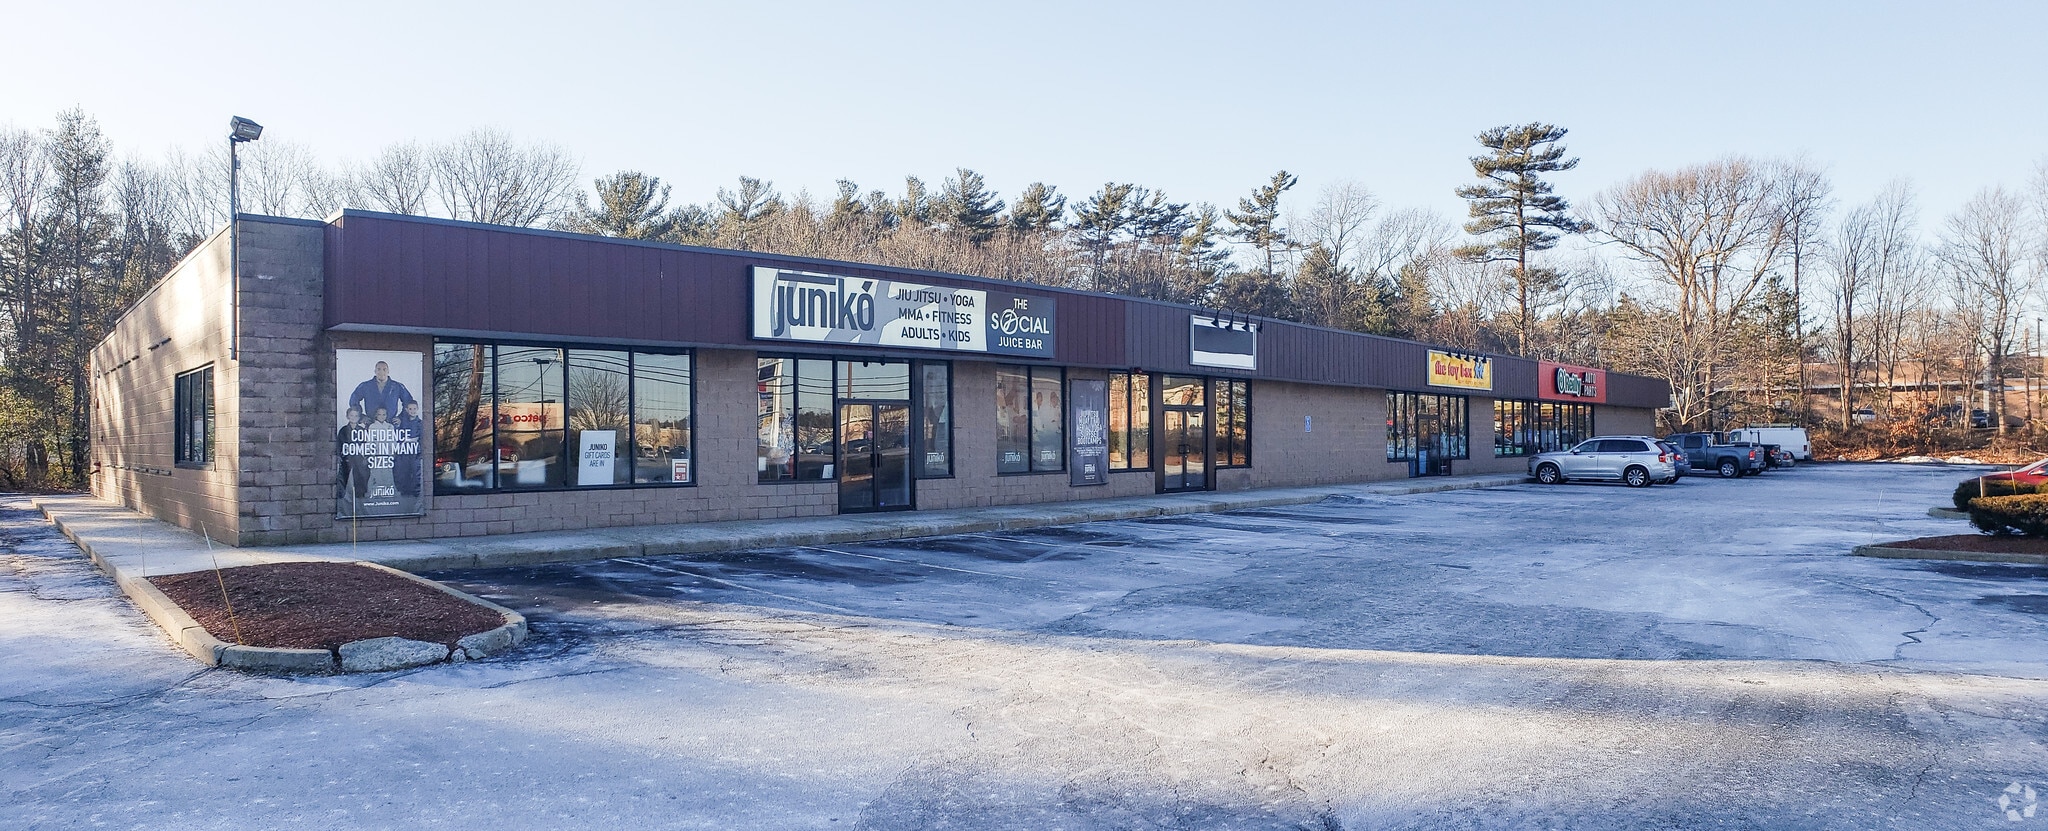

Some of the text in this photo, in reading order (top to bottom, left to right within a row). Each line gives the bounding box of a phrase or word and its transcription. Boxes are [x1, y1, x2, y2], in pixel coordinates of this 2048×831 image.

[896, 288, 975, 308] JIU JITSU YOGA
[1013, 298, 1028, 310] THE
[898, 307, 972, 325] MMA FITNESS
[991, 308, 1050, 335] SOCIAL
[901, 326, 971, 342] ADULTS KIDS
[998, 336, 1043, 350] JUICE BAR
[1447, 361, 1459, 381] toy
[1584, 371, 1597, 384] AUTO
[1583, 384, 1598, 397] PARTS
[351, 429, 411, 442] CONFIDENCE
[342, 442, 419, 456] COMES IN MANY
[584, 451, 611, 459] GIFT CARDS
[367, 456, 395, 469] SIZES
